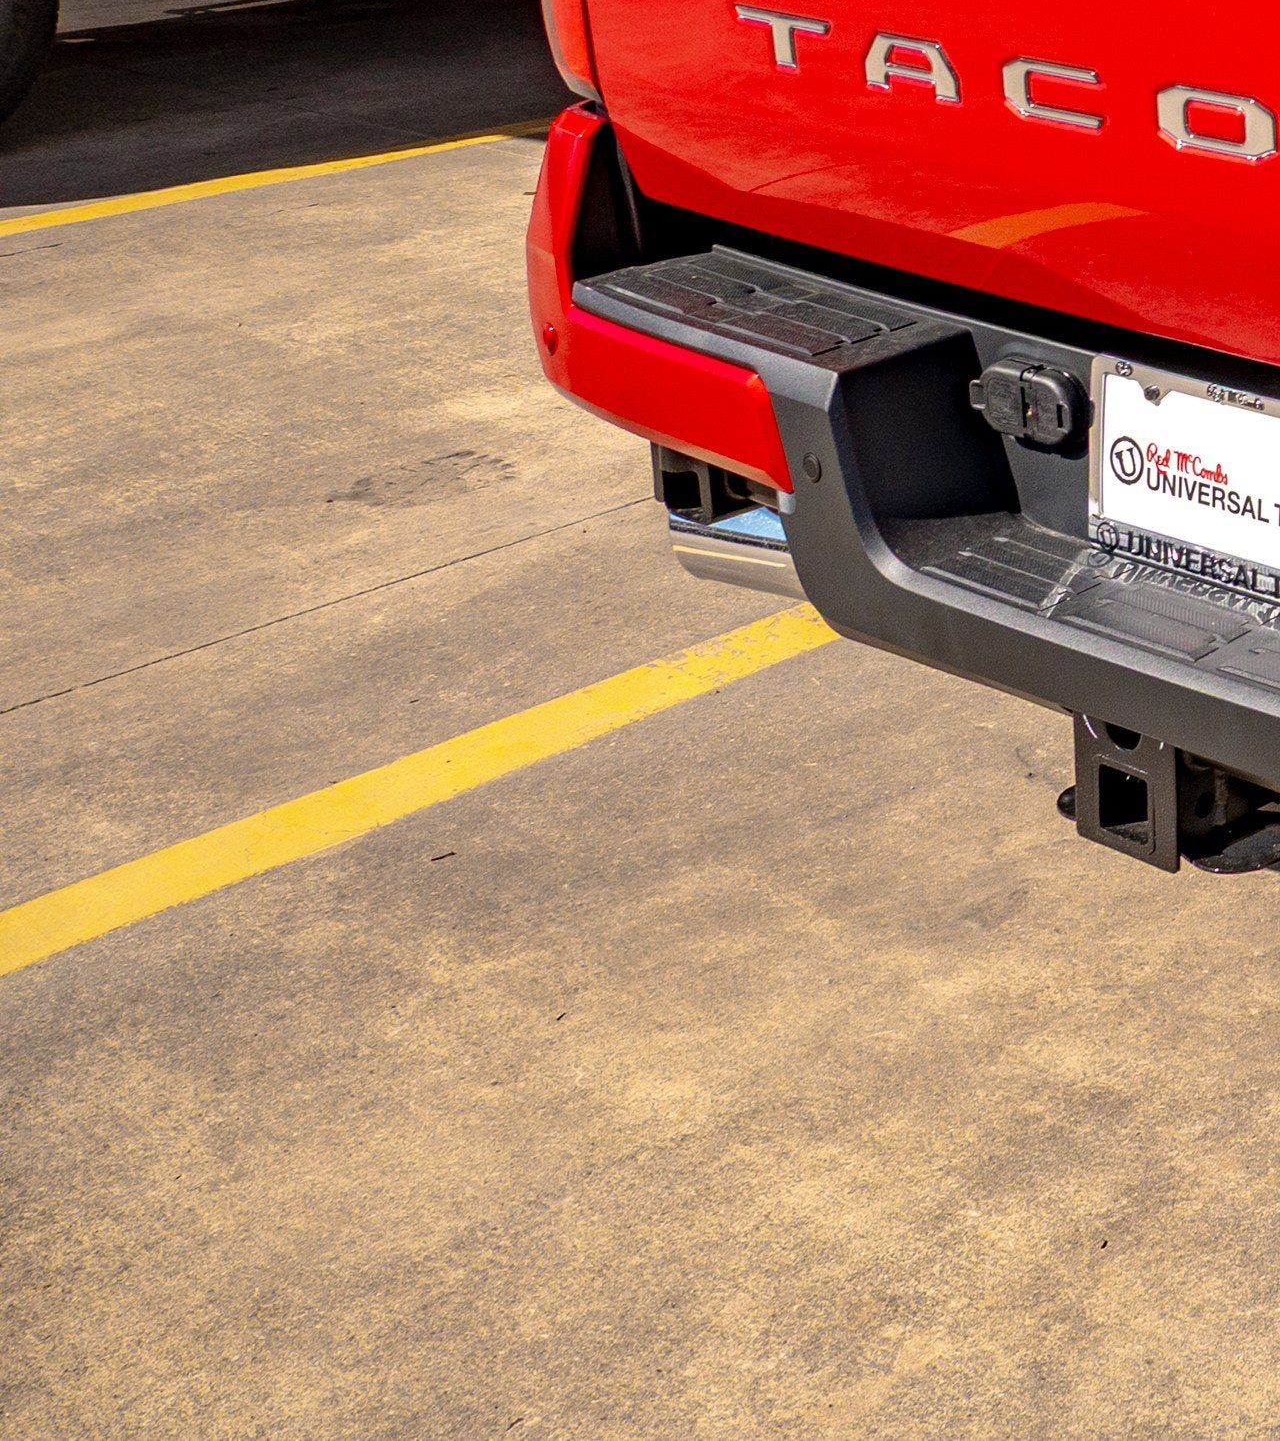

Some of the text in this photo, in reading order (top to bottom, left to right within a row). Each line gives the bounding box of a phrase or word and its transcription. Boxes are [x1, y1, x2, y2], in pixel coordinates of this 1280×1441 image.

[1146, 443, 1229, 486] Red McCombs
[1146, 467, 1270, 524] UNIVERSAL
[1126, 530, 1268, 595] UNIVERSAL
